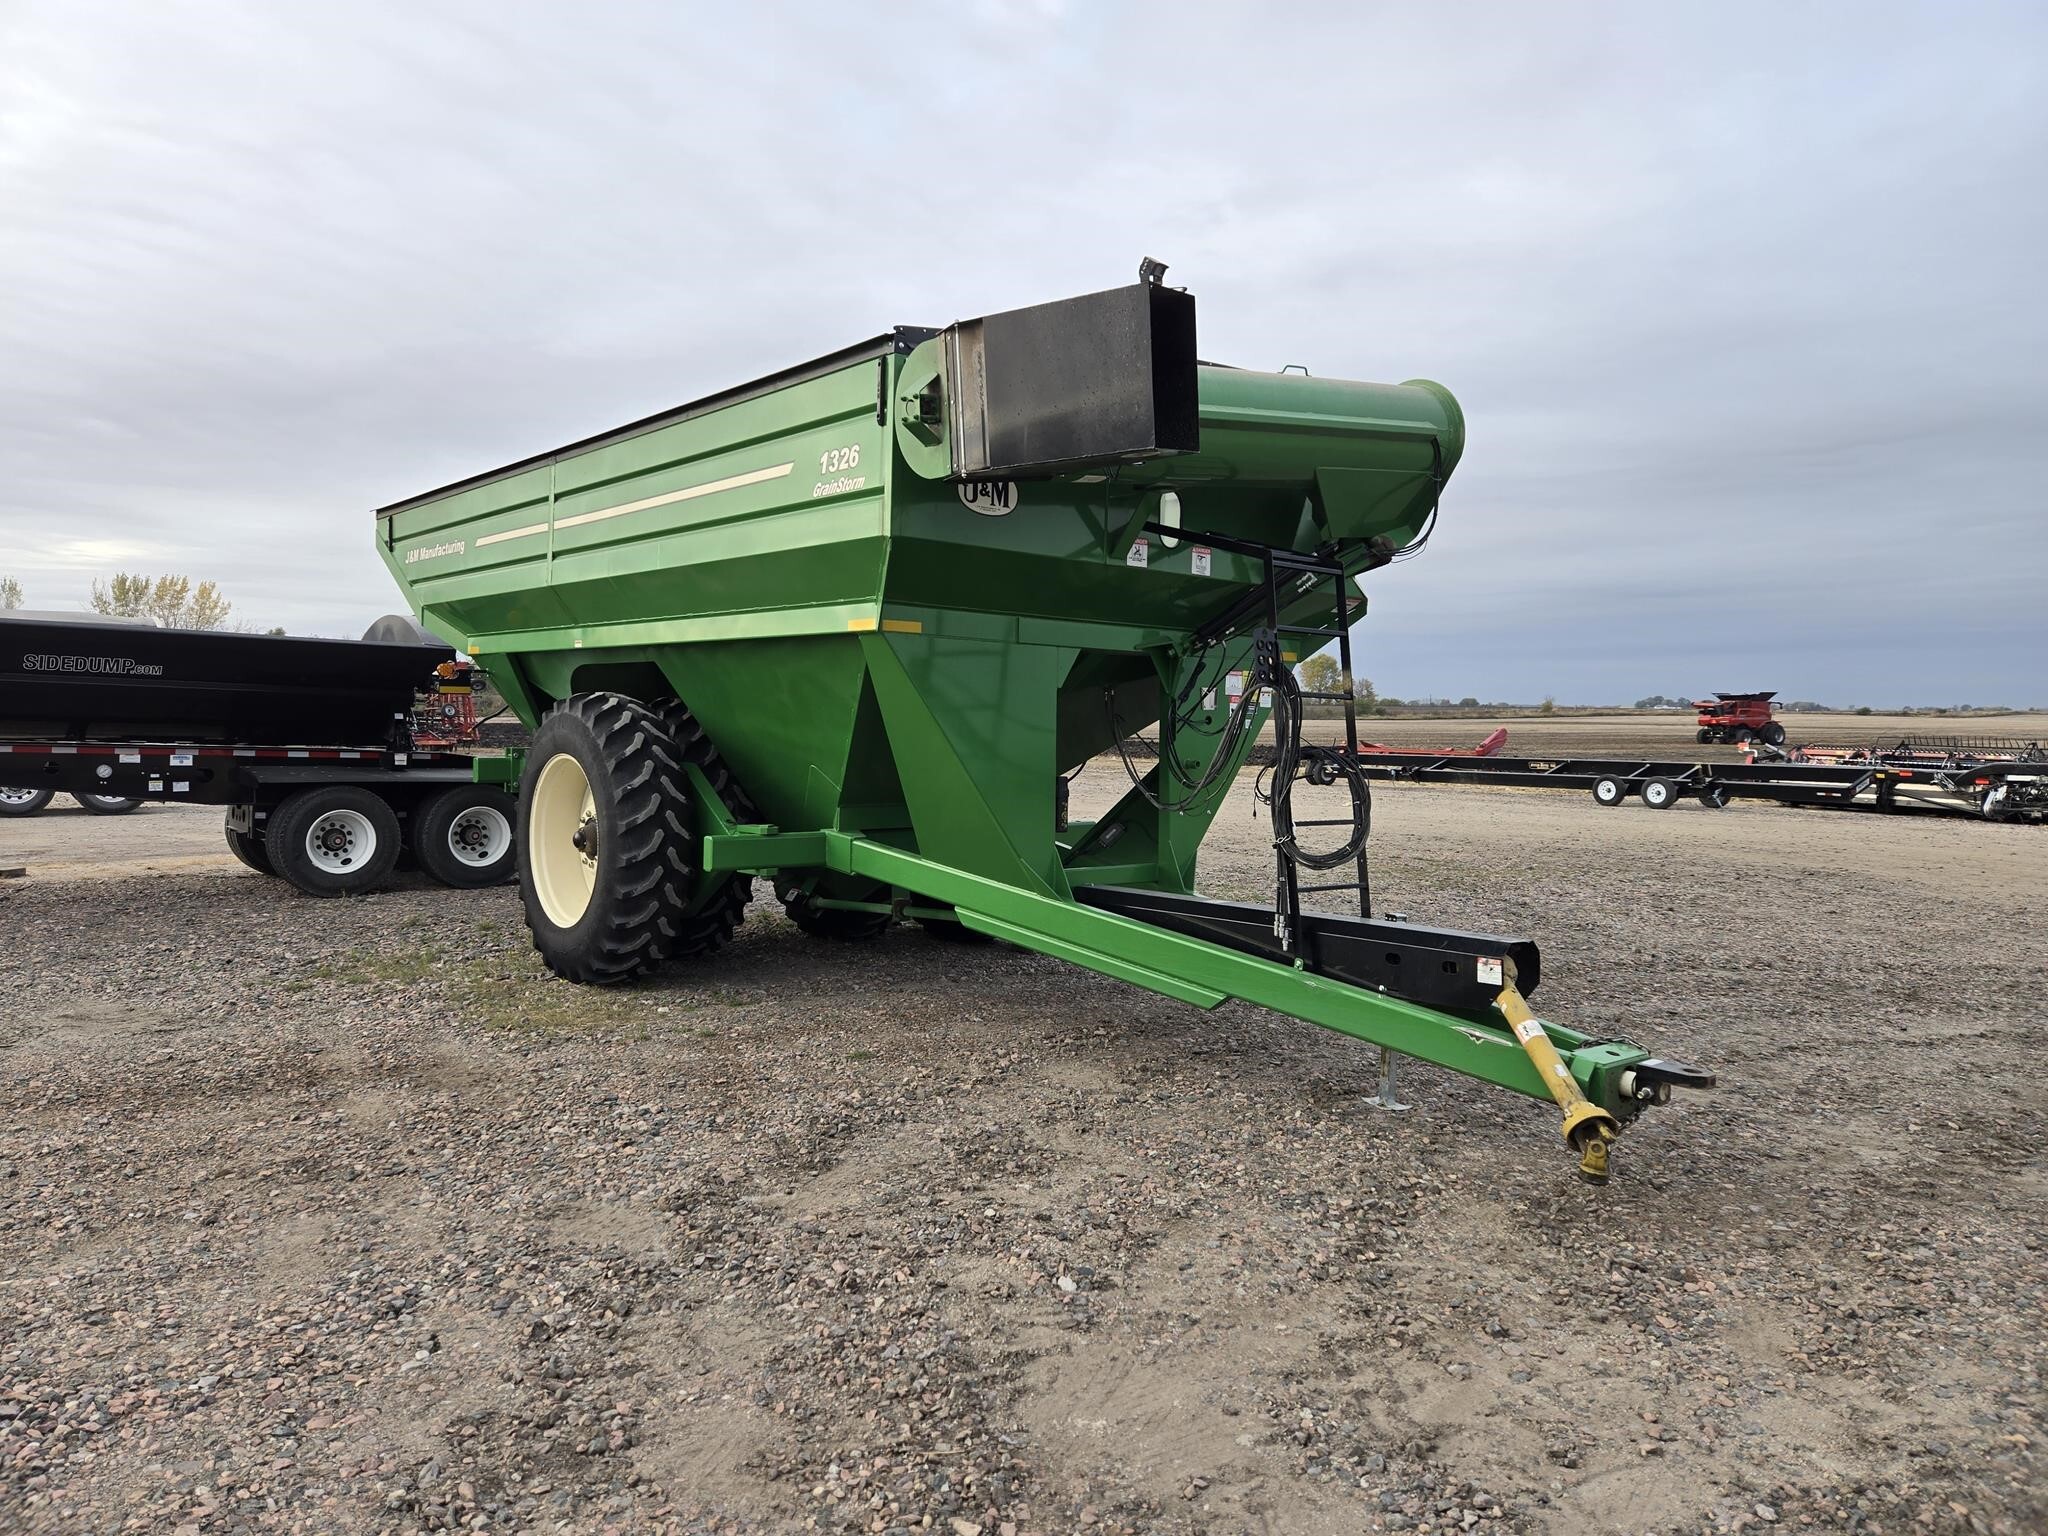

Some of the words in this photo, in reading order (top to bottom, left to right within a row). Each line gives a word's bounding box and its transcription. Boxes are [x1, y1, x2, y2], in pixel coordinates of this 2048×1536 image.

[820, 444, 860, 475] 1326
[813, 476, 866, 498] GrainStorm
[405, 549, 419, 564] J&M
[420, 540, 465, 561] Manufacturing
